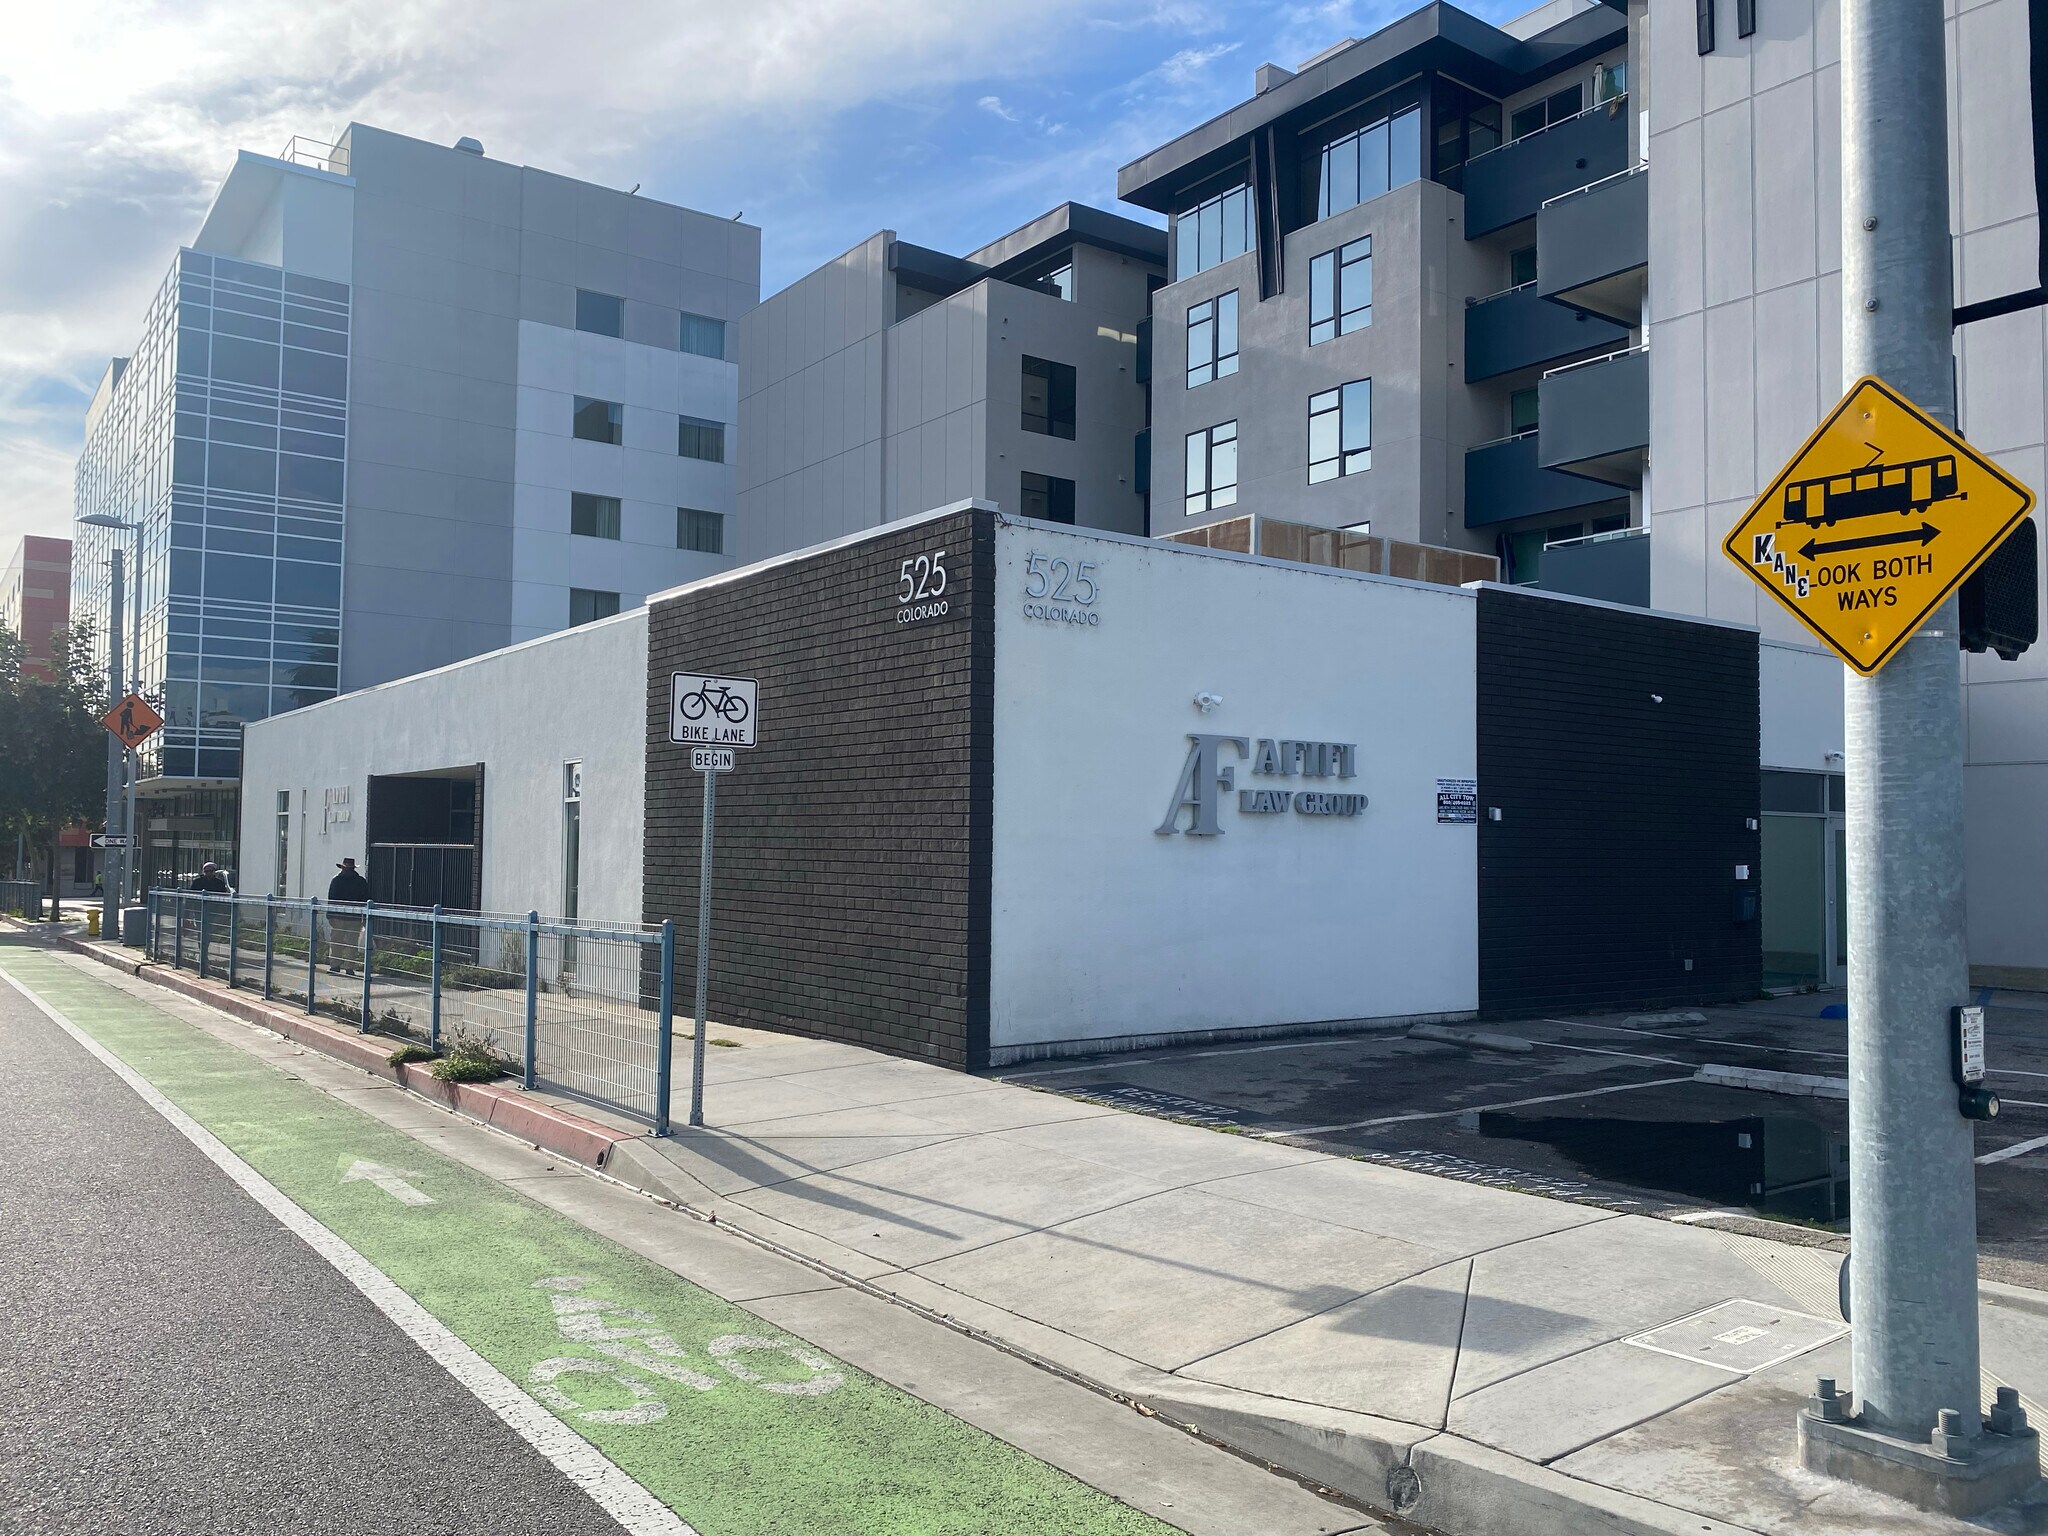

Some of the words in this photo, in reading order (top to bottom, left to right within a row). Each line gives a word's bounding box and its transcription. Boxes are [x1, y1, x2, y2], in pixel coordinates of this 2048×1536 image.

[898, 550, 948, 604] 525
[1025, 553, 1098, 606] 525
[1873, 553, 1932, 580] BOTH
[1837, 586, 1898, 611] WAYS
[897, 600, 949, 624] COLORADO
[1023, 603, 1100, 627] COLORADO
[682, 725, 709, 740] BIKE
[714, 727, 746, 742] LANE
[695, 752, 731, 767] BEGIN
[1252, 738, 1358, 778] AFIFI
[1239, 789, 1294, 813] LAW
[1294, 791, 1369, 816] GROUP
